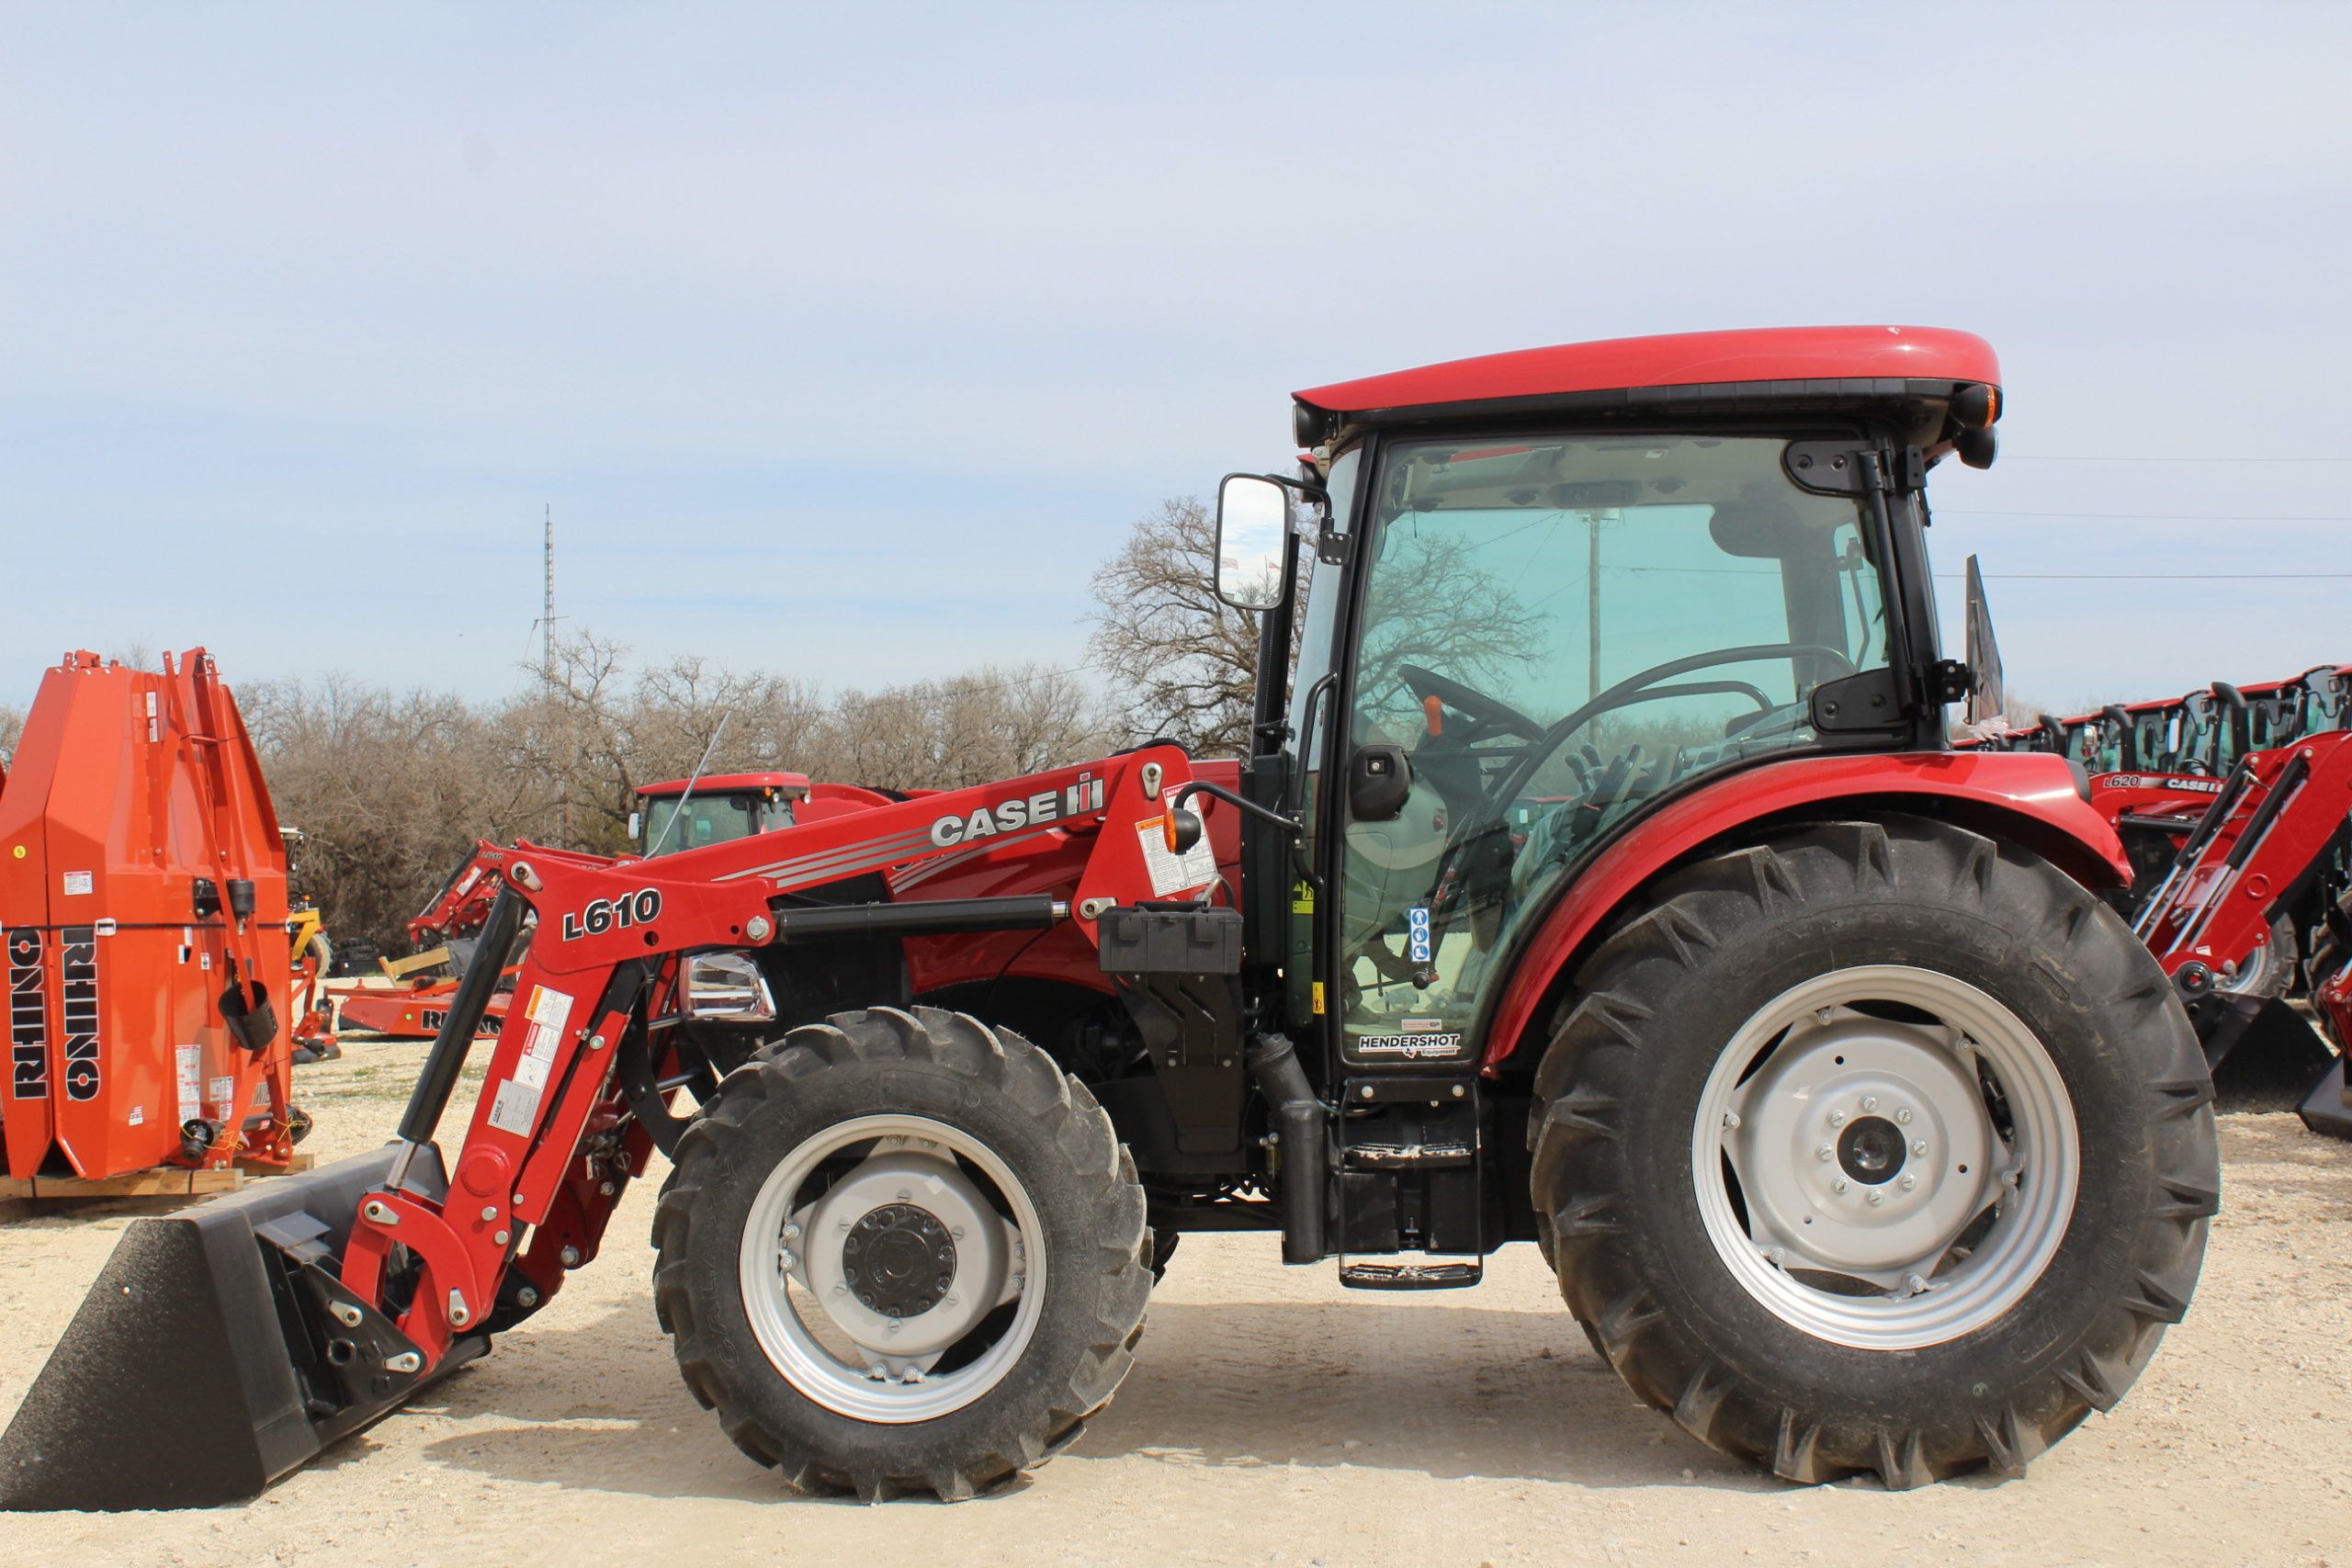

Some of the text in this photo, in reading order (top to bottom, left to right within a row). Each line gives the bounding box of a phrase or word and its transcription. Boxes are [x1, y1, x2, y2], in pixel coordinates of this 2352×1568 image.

[2103, 774, 2141, 789] L620
[2166, 778, 2209, 792] CASE
[931, 790, 1057, 847] CASE
[562, 887, 662, 942] L610
[7, 925, 49, 1100] RHINO
[61, 927, 101, 1101] RHINO
[1360, 1034, 1459, 1048] HENDERSHOT
